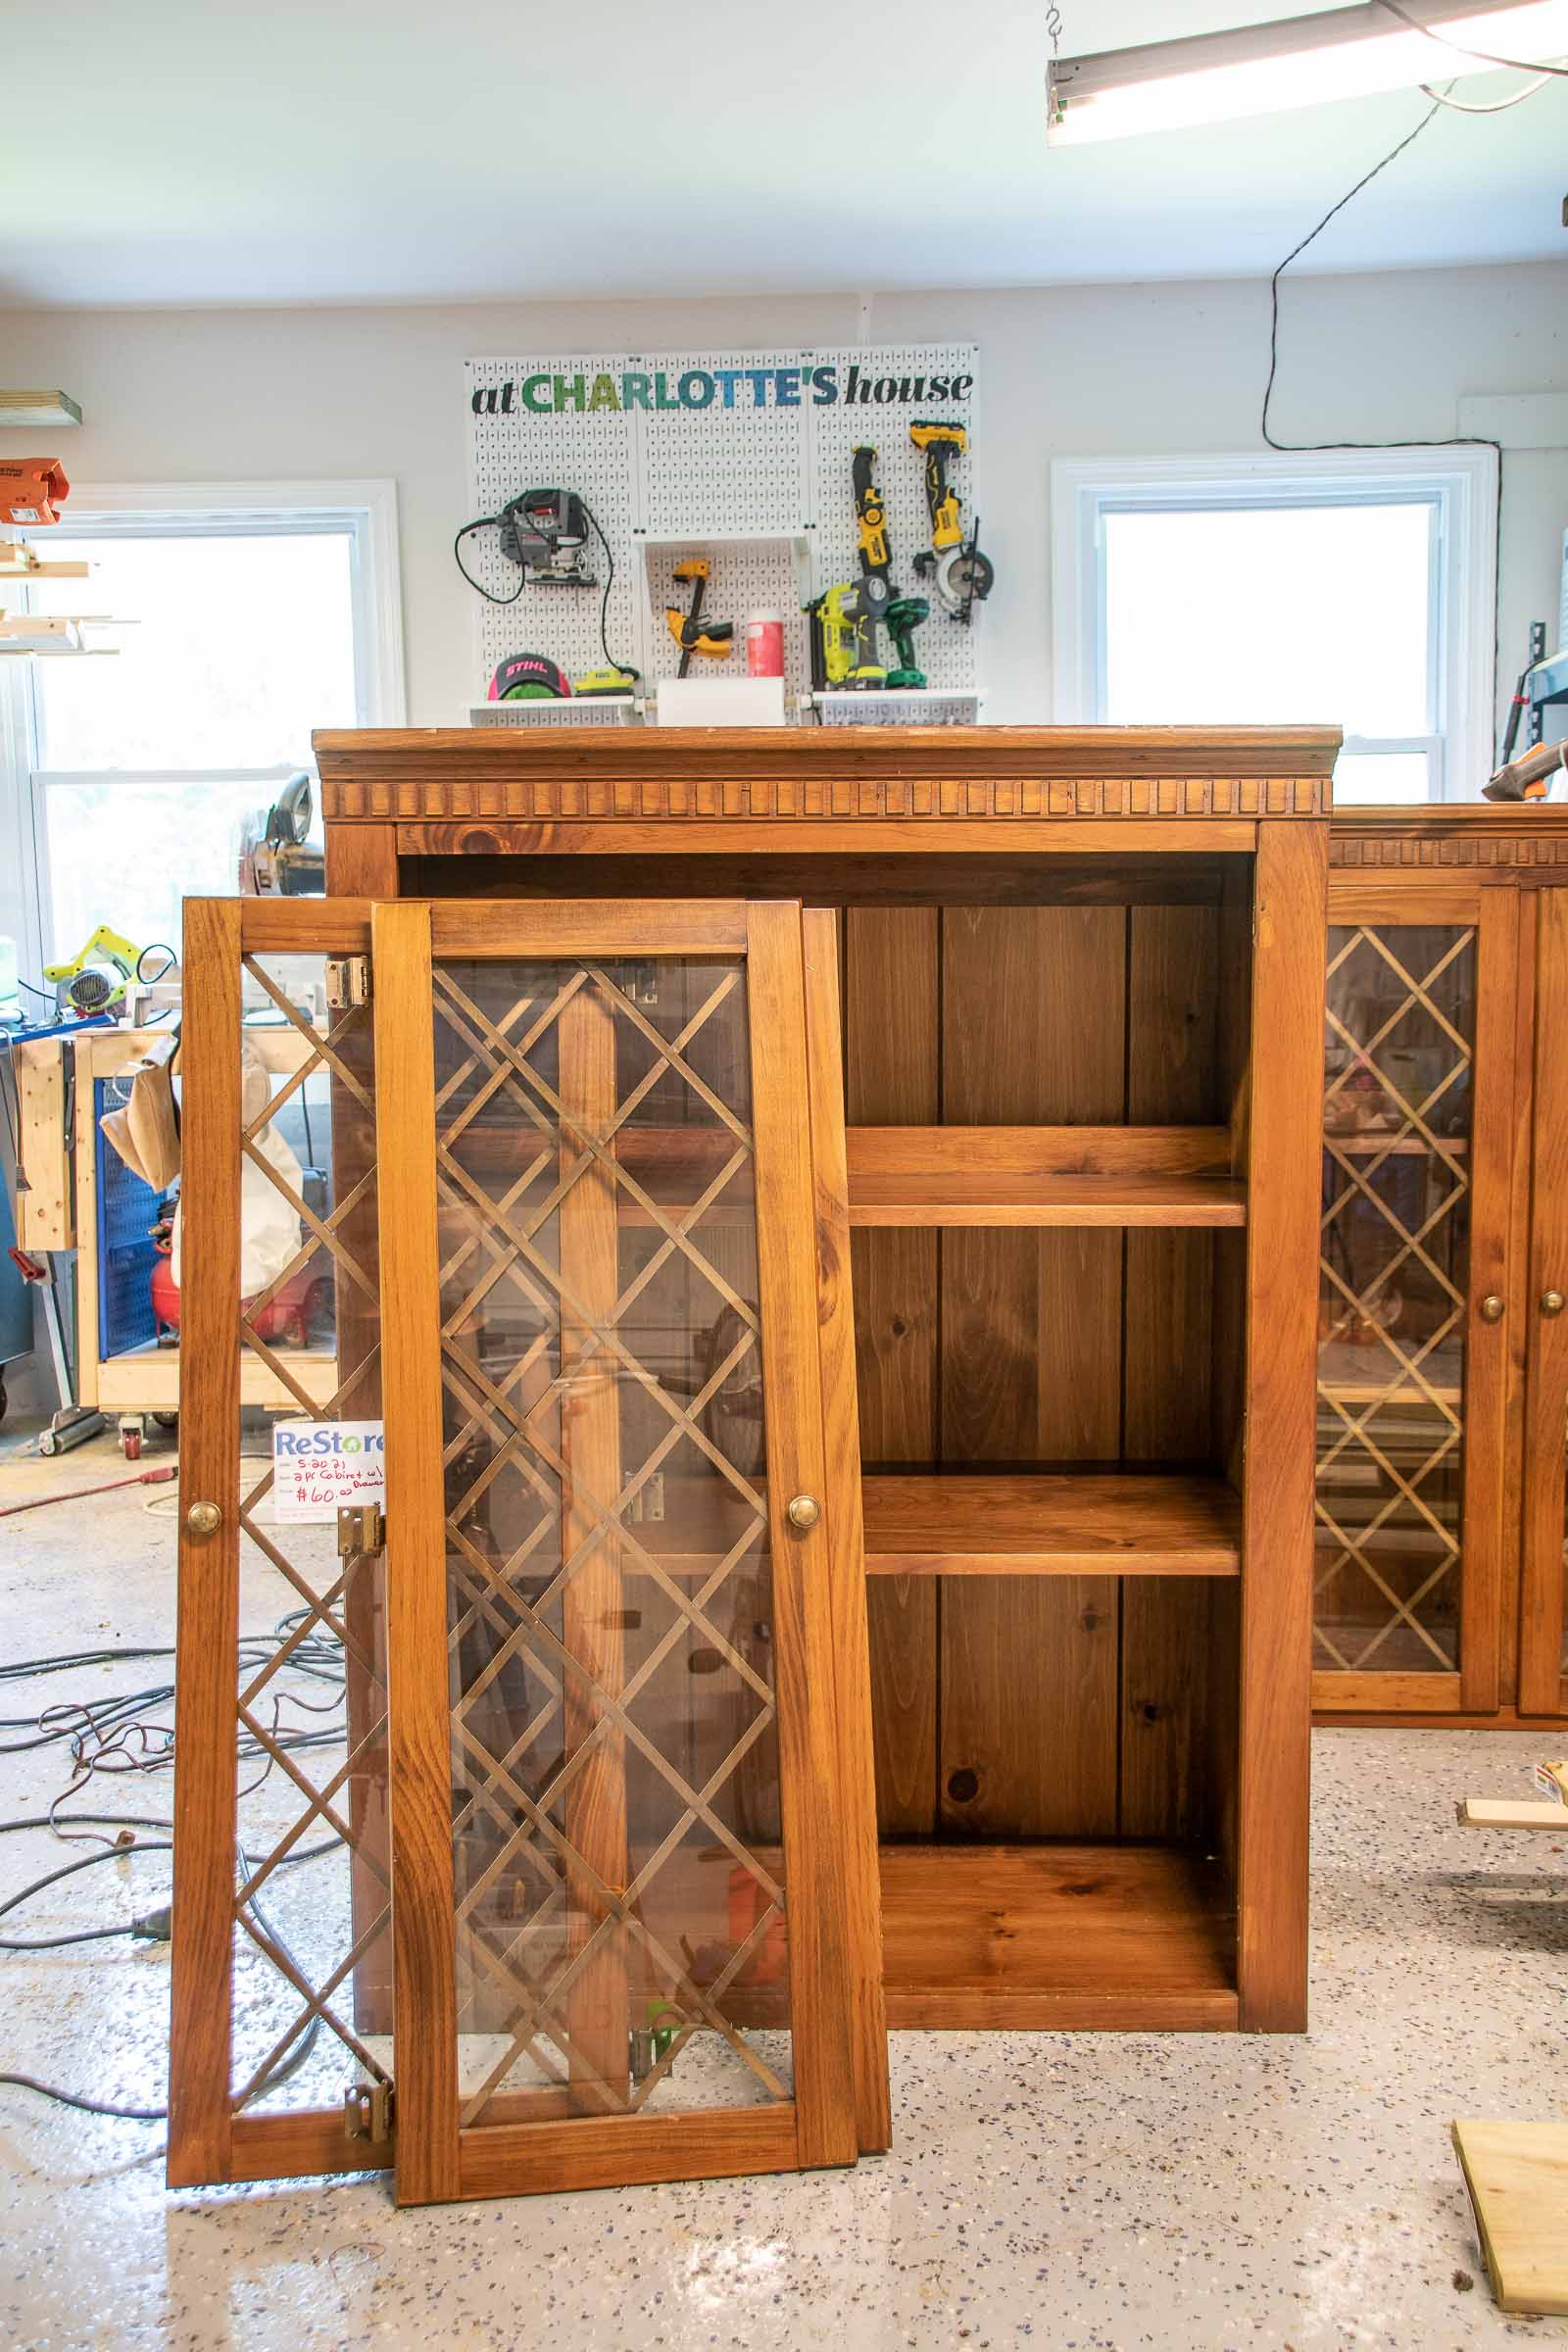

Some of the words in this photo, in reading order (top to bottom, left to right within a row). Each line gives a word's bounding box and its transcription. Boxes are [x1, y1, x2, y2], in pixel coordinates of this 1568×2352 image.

[471, 382, 517, 415] at
[522, 367, 839, 413] CHARLOTTE'S
[844, 366, 973, 405] house
[506, 661, 549, 677] STIHL
[319, 1469, 362, 1480] Cabinet
